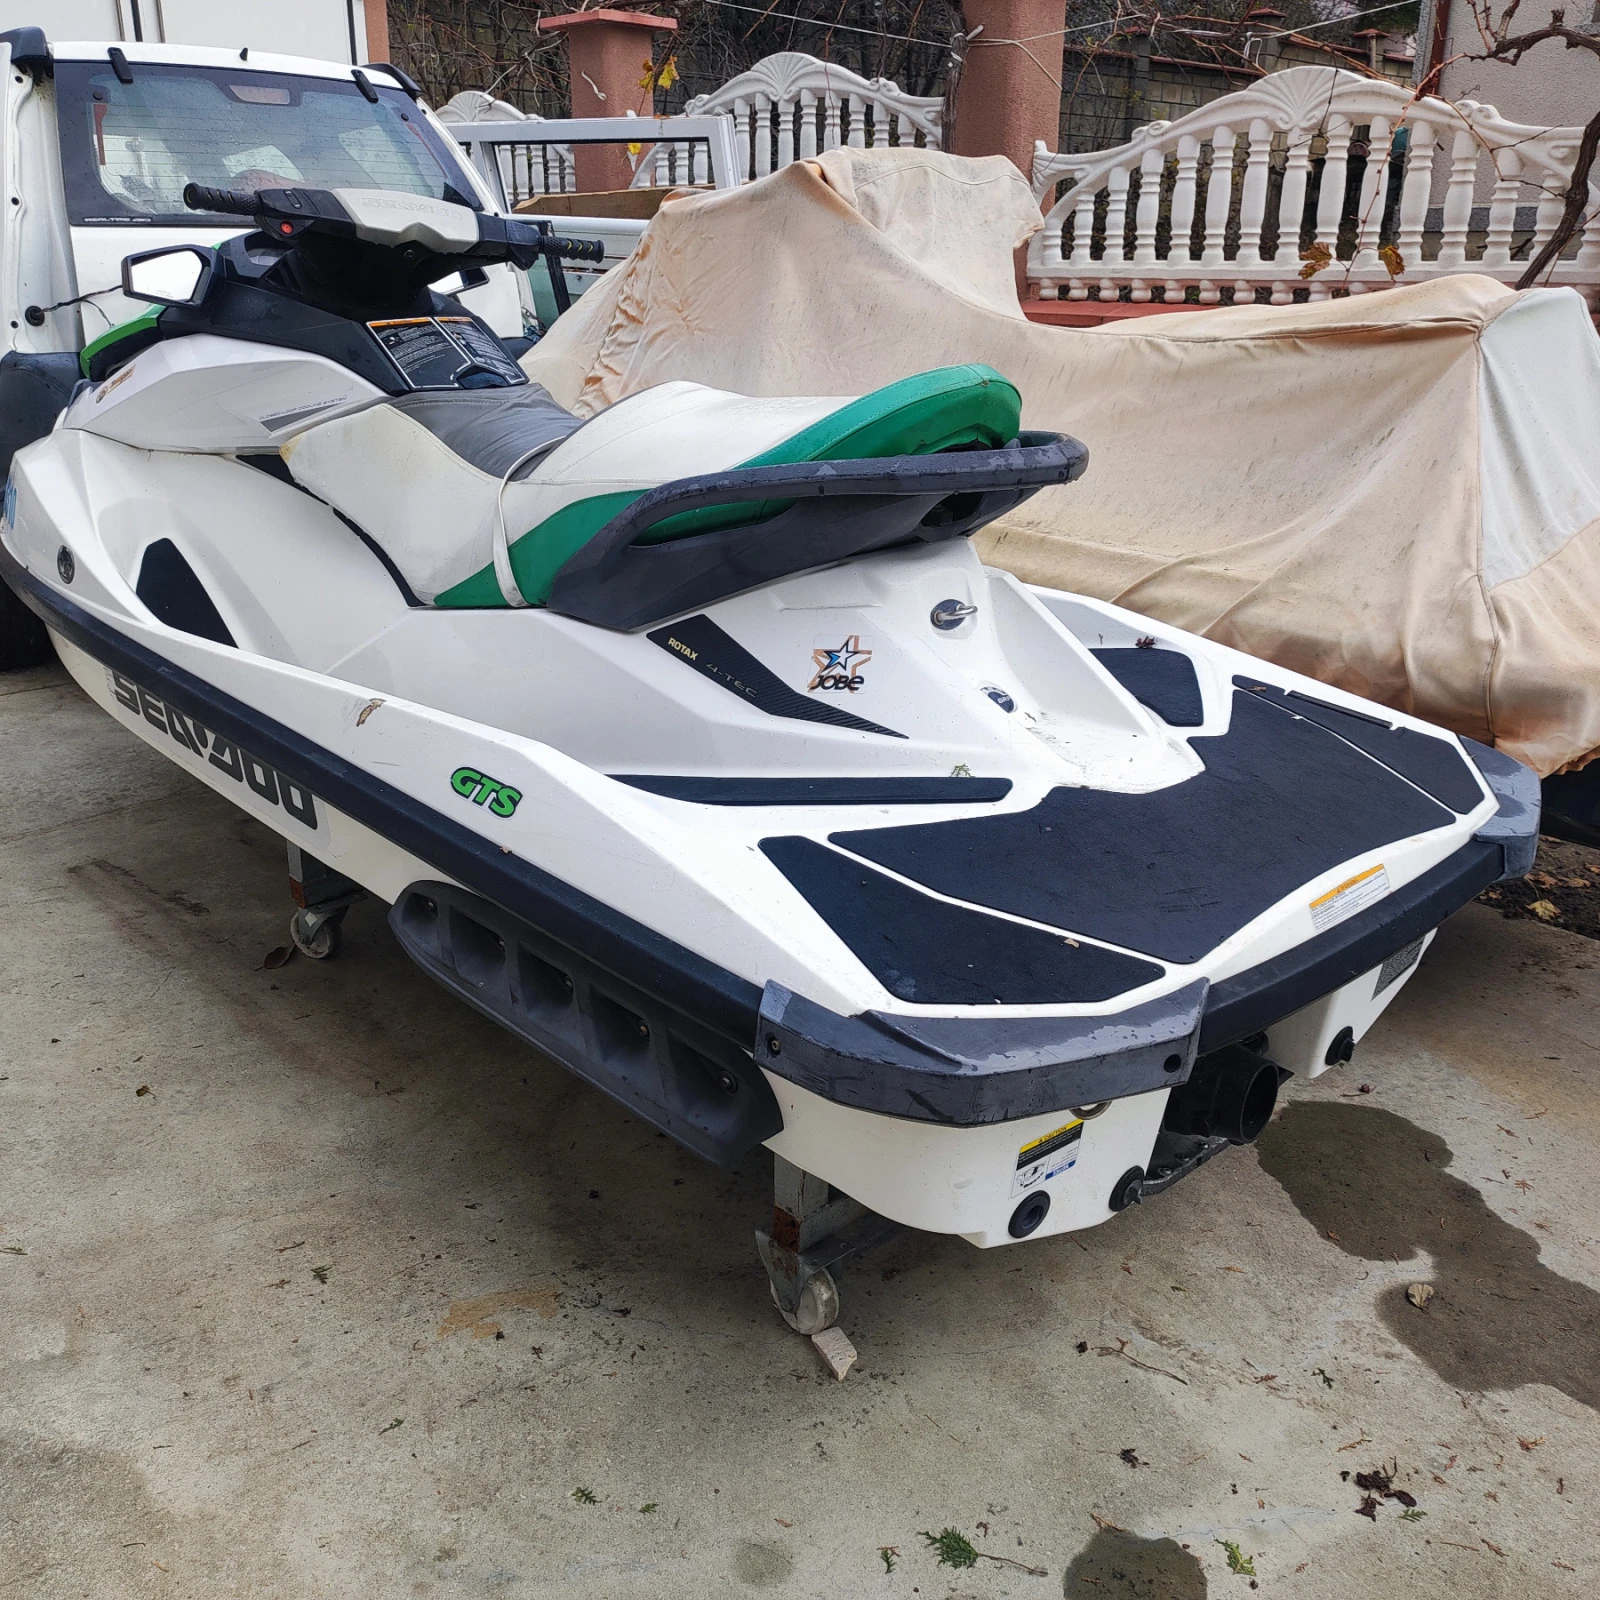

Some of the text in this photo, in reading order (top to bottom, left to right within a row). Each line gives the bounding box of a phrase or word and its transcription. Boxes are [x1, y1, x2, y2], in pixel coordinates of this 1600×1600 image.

[667, 636, 759, 698] ROTAX 4-TEC
[997, 695, 1011, 704] BRP
[451, 767, 523, 818] GTS
